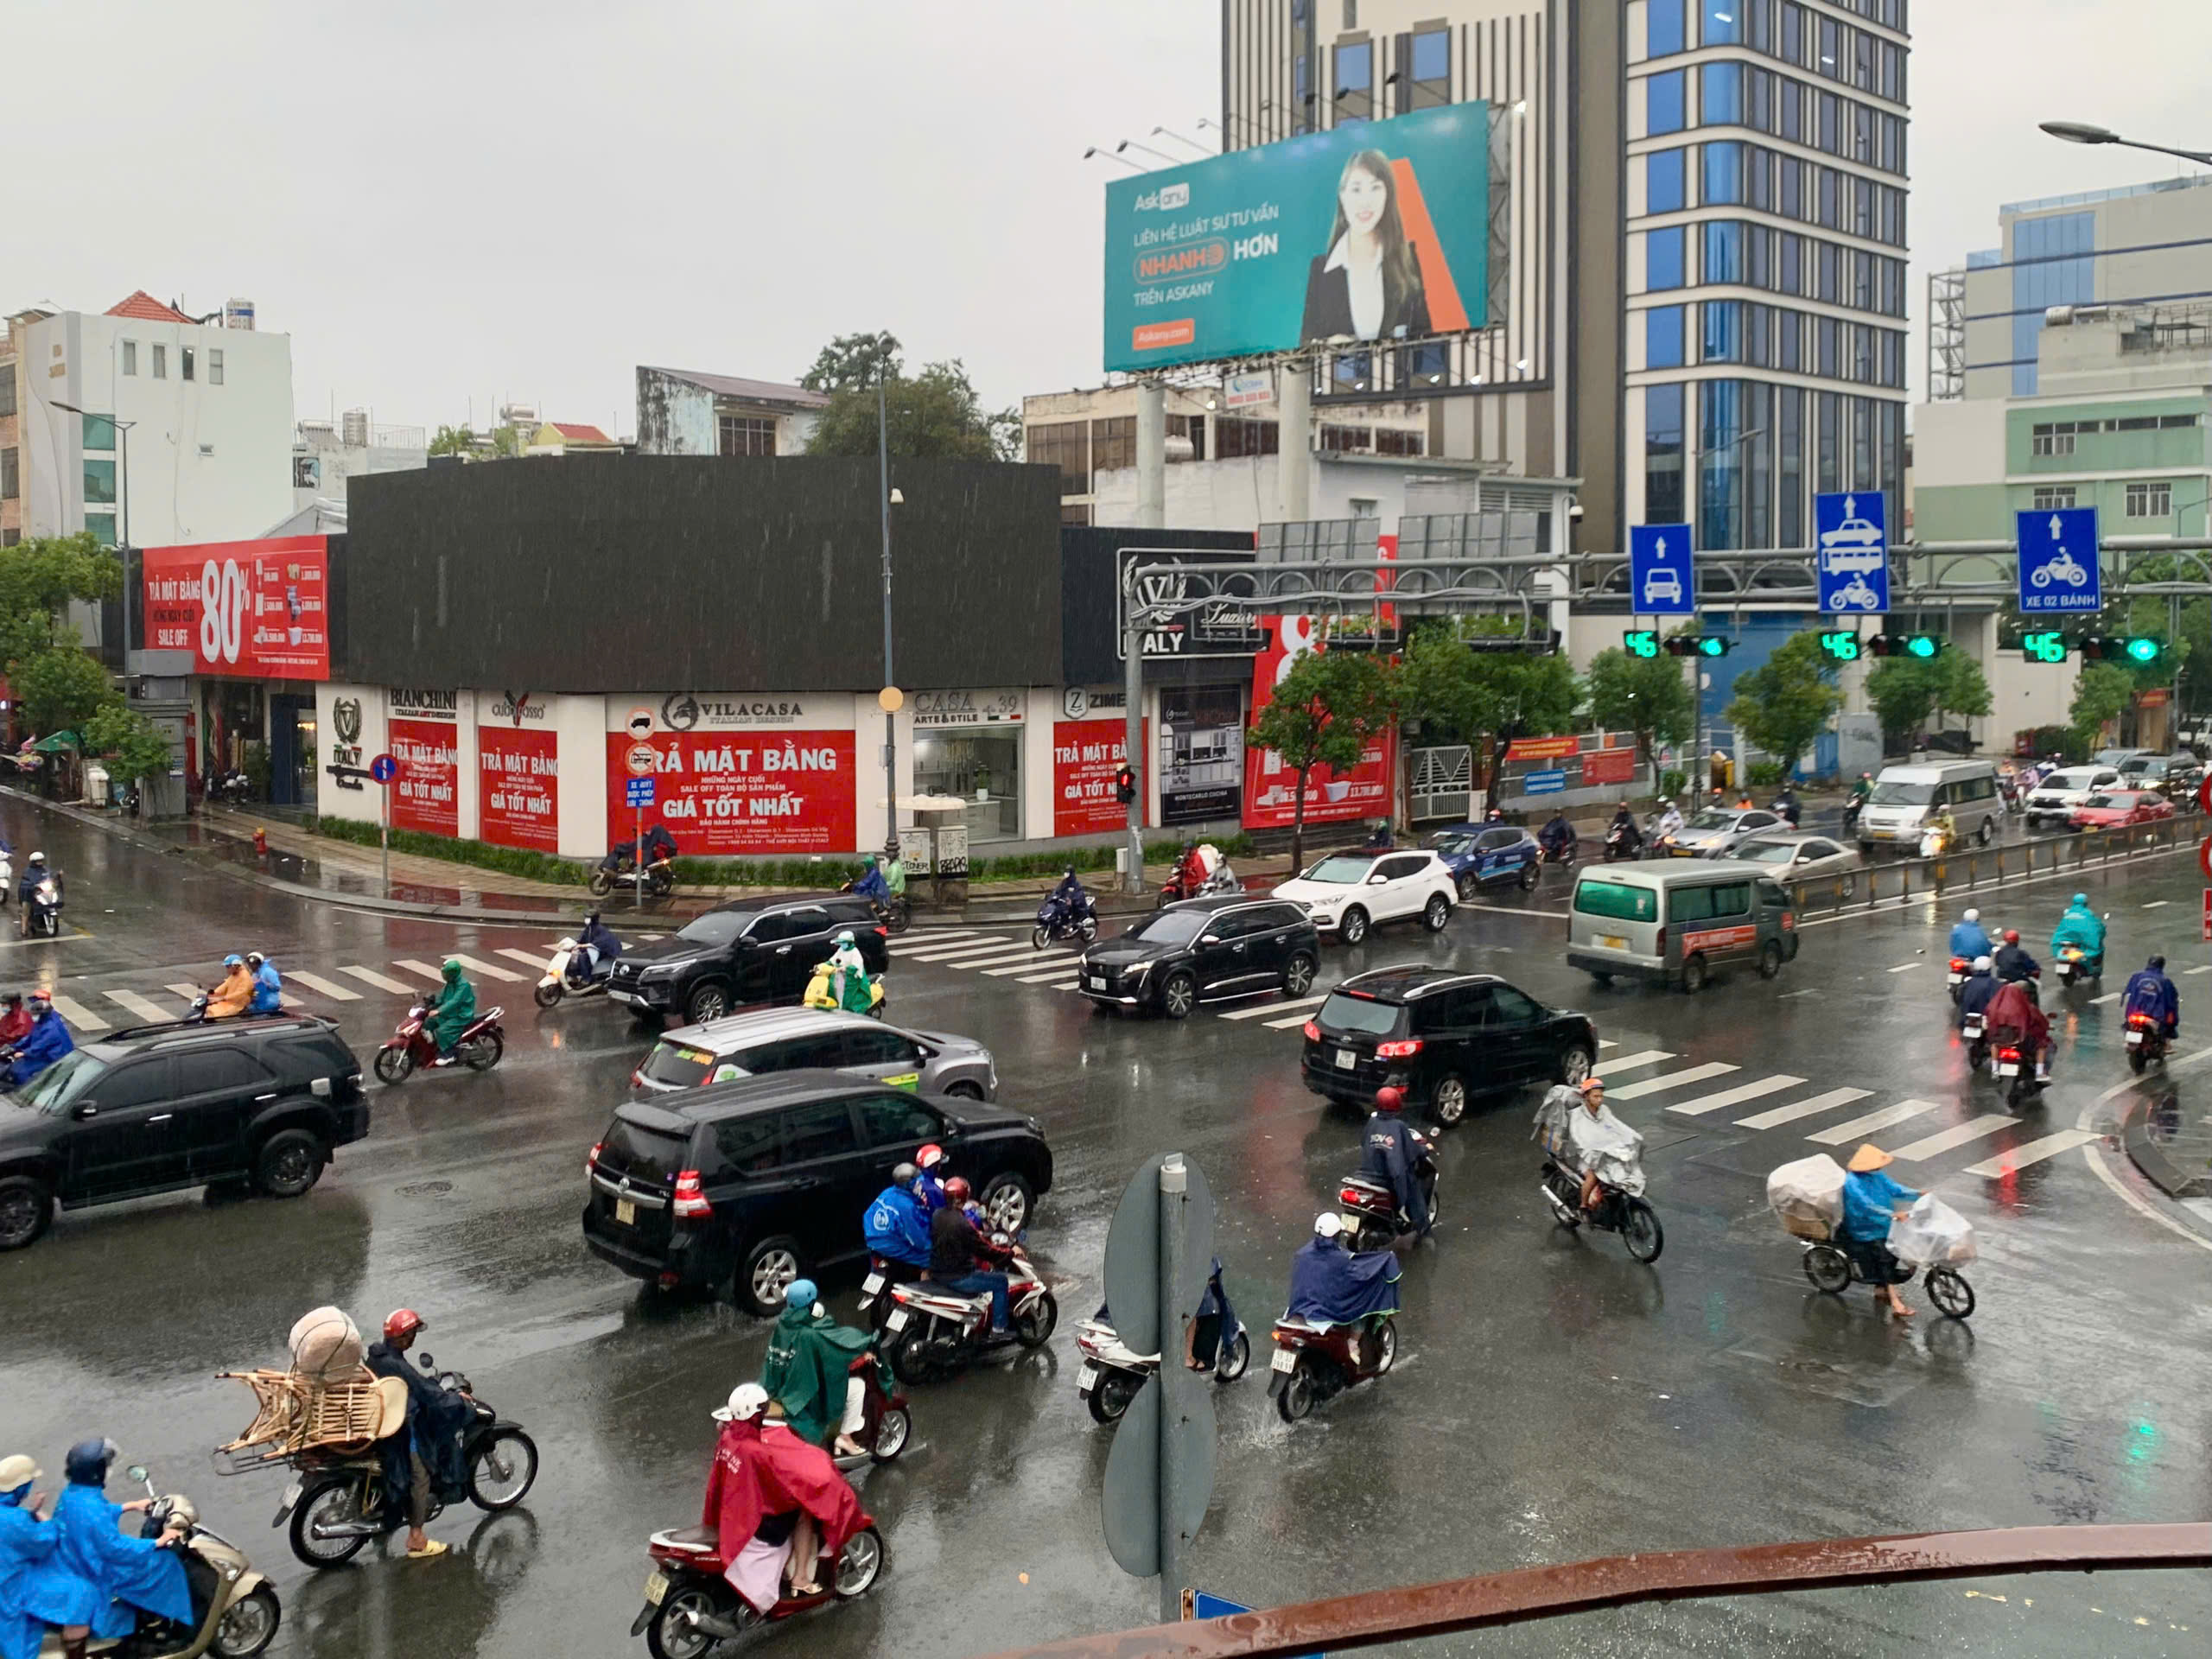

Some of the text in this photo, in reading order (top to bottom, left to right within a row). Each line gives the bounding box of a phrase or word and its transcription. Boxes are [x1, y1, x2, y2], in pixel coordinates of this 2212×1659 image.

[1160, 221, 1177, 244] HỆ
[1179, 217, 1210, 238] LUẬT
[1251, 200, 1279, 223] VẤN
[1140, 232, 1278, 276] NHANH HƠN
[1133, 280, 1214, 307] TRÊN ASKANY
[179, 572, 200, 601] BẰNG
[2026, 592, 2095, 607] XE 02 BÁNH
[158, 629, 188, 646] SALE OFF
[1123, 632, 1184, 653] IALY
[1625, 631, 1658, 658] 46
[1821, 632, 1858, 660] 46
[2024, 632, 2064, 663] 46
[391, 689, 457, 710] BIANCHINI
[701, 702, 804, 716] VILACASA
[915, 691, 977, 712] CASA
[1090, 692, 1127, 709] ZIME
[412, 742, 432, 765] MẶT
[481, 747, 501, 772] TRẢ
[505, 751, 528, 775] MẶT
[694, 745, 753, 776] MẶT
[763, 739, 836, 771] BẰNG
[1054, 736, 1127, 764] TRẢ MẶT BẰ
[399, 779, 453, 802] GIÁ TỐT NHẤT
[1065, 781, 1083, 798] GIÁ
[1084, 779, 1105, 797] TỐT
[490, 790, 551, 815] GIÁ TỐT NHẤT
[663, 791, 804, 818] GIÁ TỐT NHẤT
